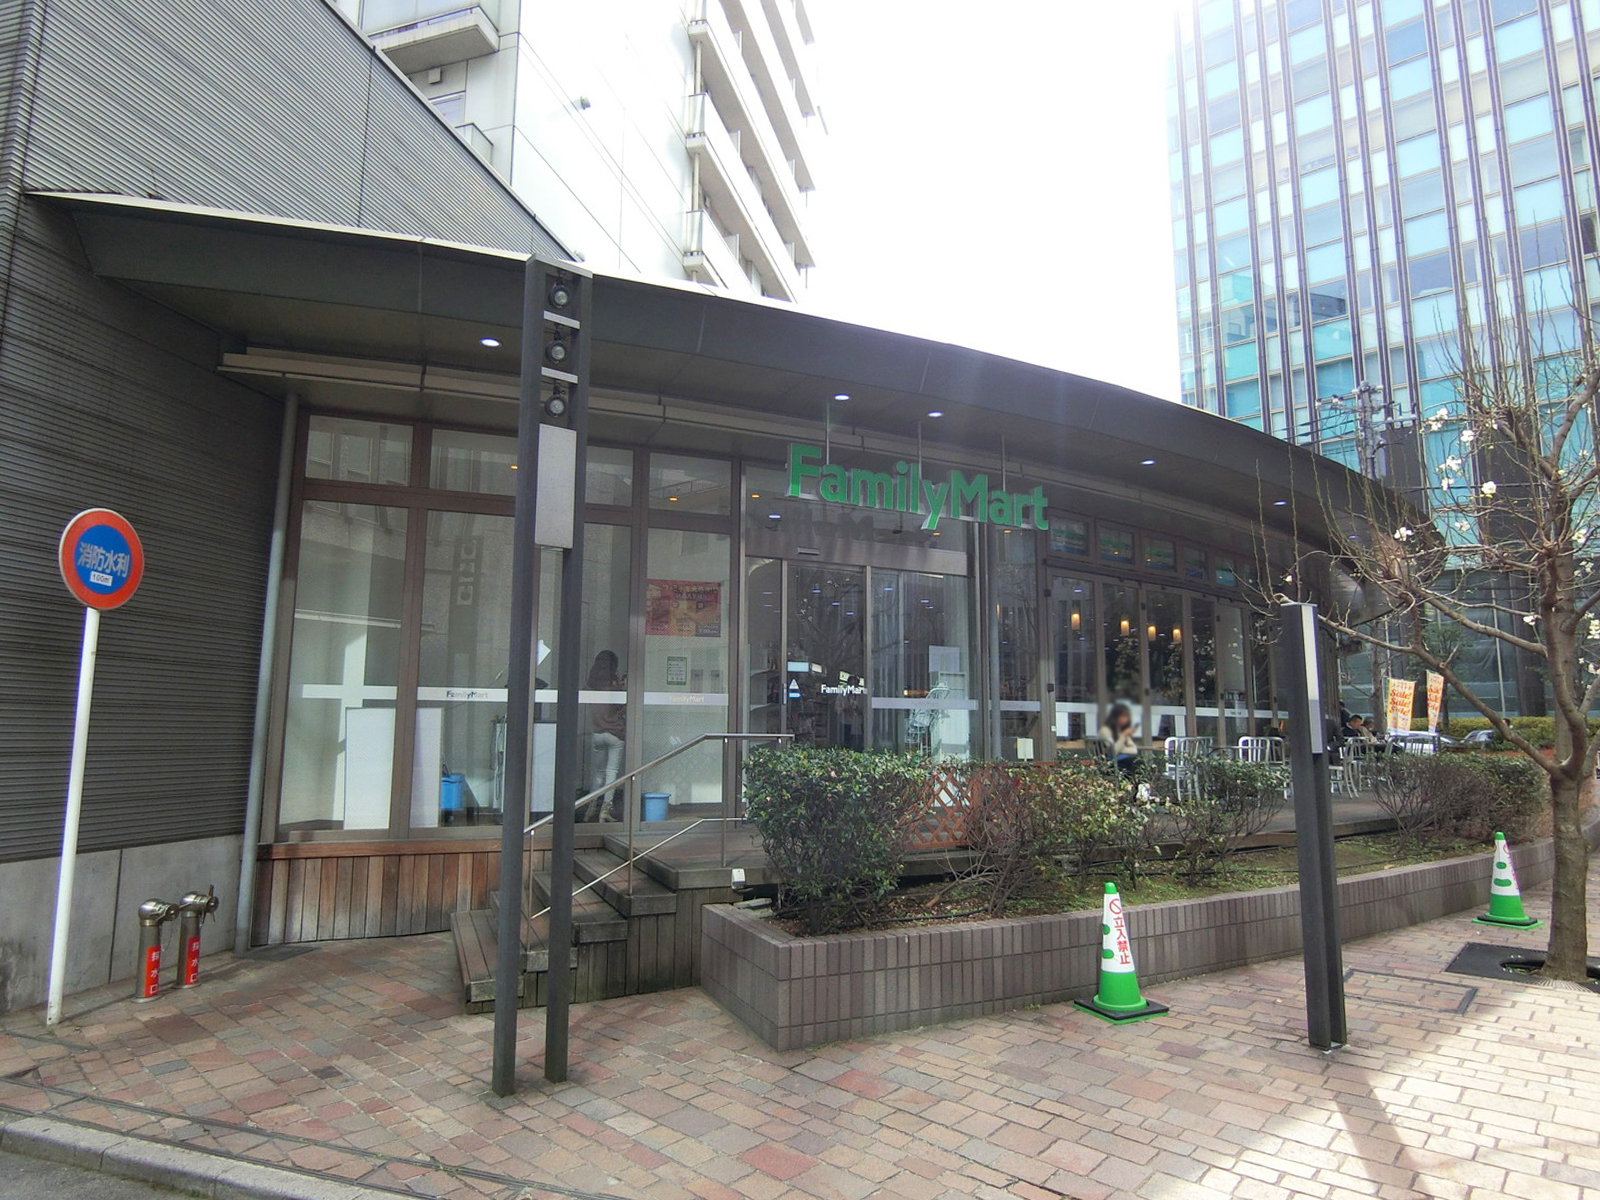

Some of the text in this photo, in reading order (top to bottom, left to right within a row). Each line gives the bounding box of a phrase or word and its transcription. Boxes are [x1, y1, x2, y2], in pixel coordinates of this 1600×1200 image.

[787, 443, 1049, 530] FamilyMart
[78, 541, 130, 578] 消防水利
[446, 690, 489, 700] FamilyMart
[1113, 916, 1130, 965] 立入禁止
